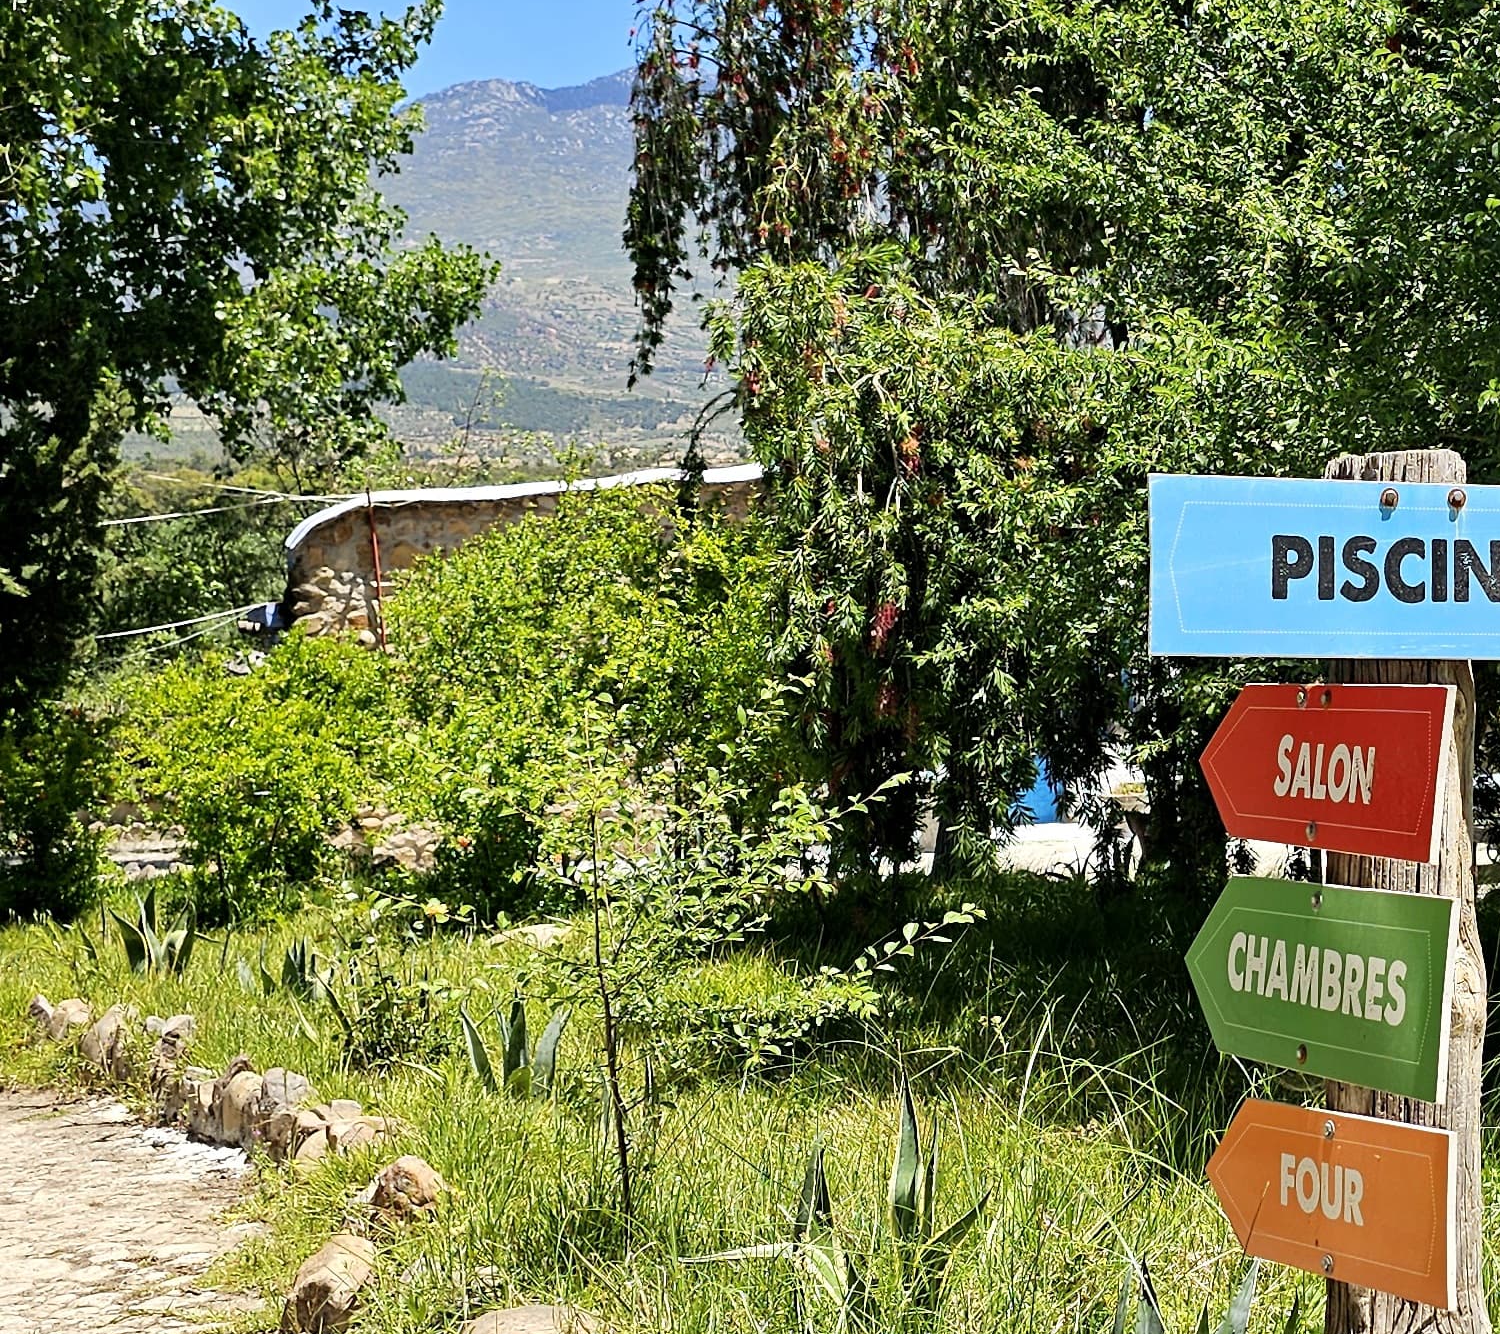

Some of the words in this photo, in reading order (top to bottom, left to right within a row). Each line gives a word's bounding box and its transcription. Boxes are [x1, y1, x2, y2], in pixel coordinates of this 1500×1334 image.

[1273, 733, 1376, 805] SALON
[1226, 931, 1407, 1026] CHAMBRES
[1279, 1153, 1365, 1227] FOUR
